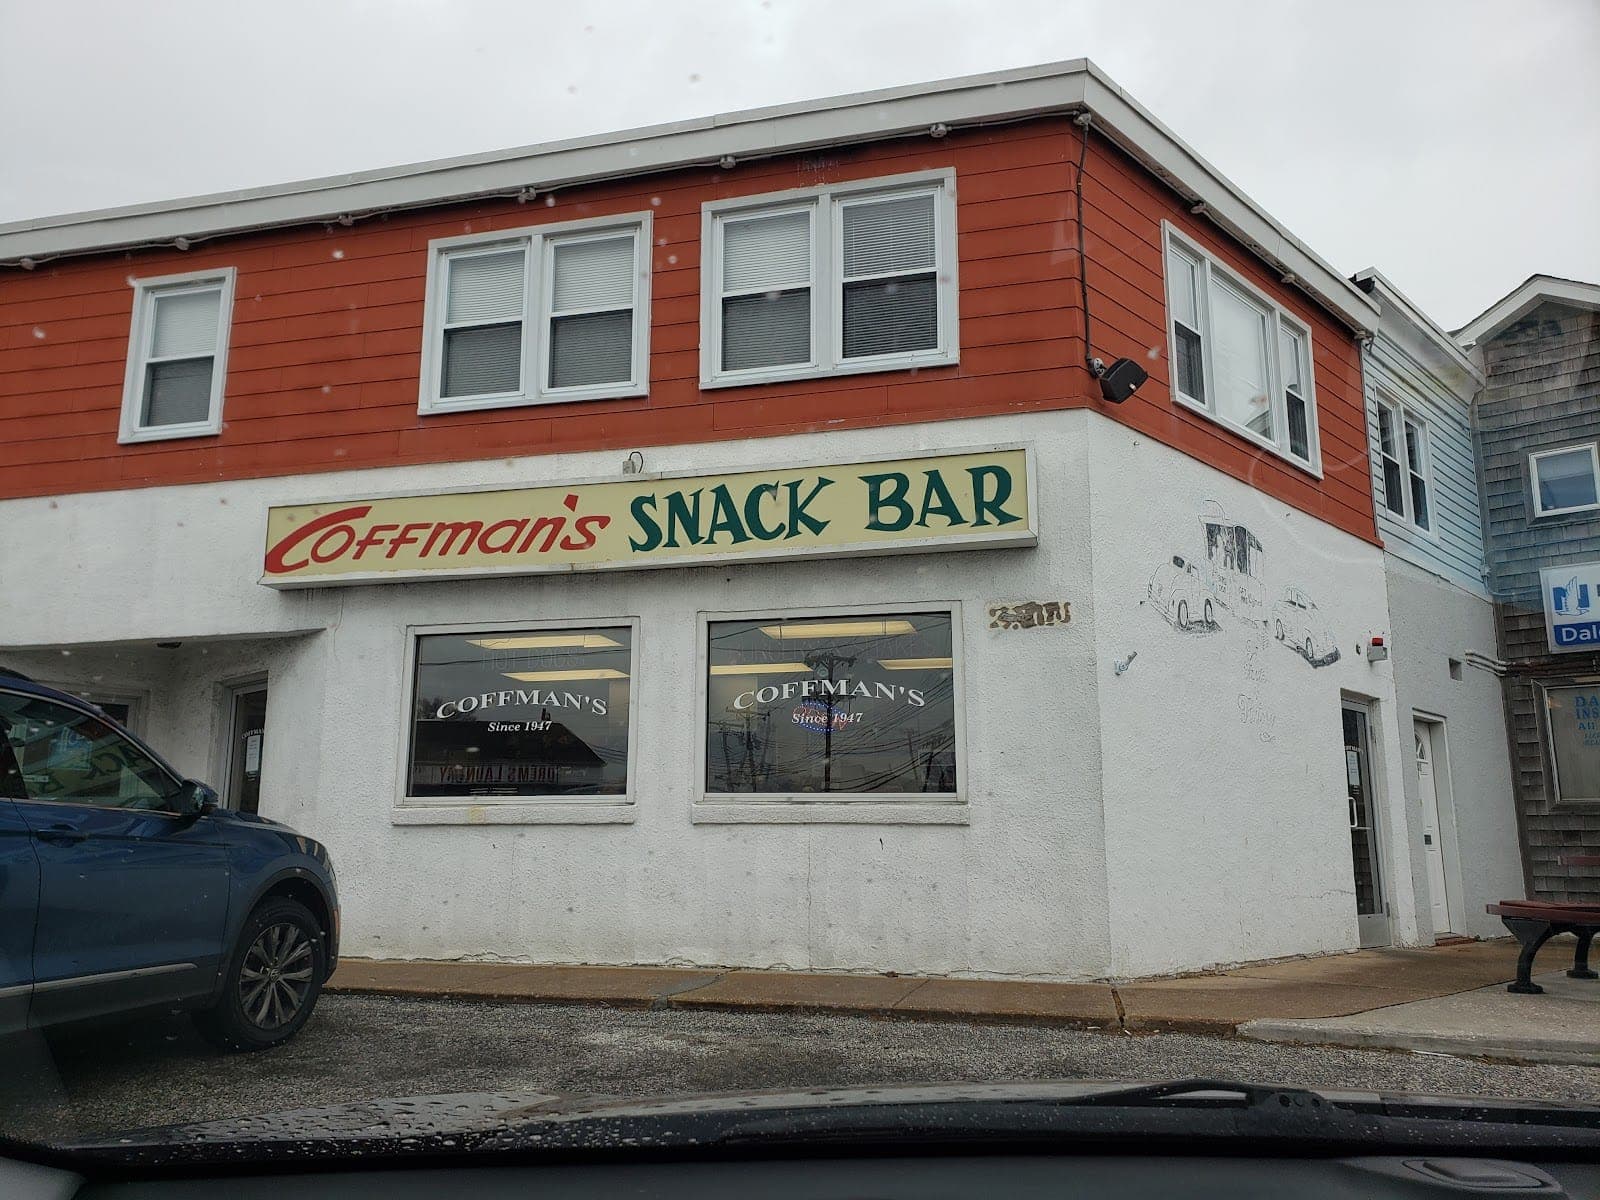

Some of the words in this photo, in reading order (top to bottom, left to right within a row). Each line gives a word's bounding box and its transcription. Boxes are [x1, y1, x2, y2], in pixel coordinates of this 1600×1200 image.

[629, 477, 834, 552] SNACK
[858, 465, 1023, 532] BAR
[436, 689, 608, 719] COFFMAN'S
[733, 679, 926, 710] COFFMAN'S
[487, 721, 521, 732] Since
[524, 720, 553, 731] 1947
[791, 713, 828, 724] Since
[833, 712, 863, 723] 1947
